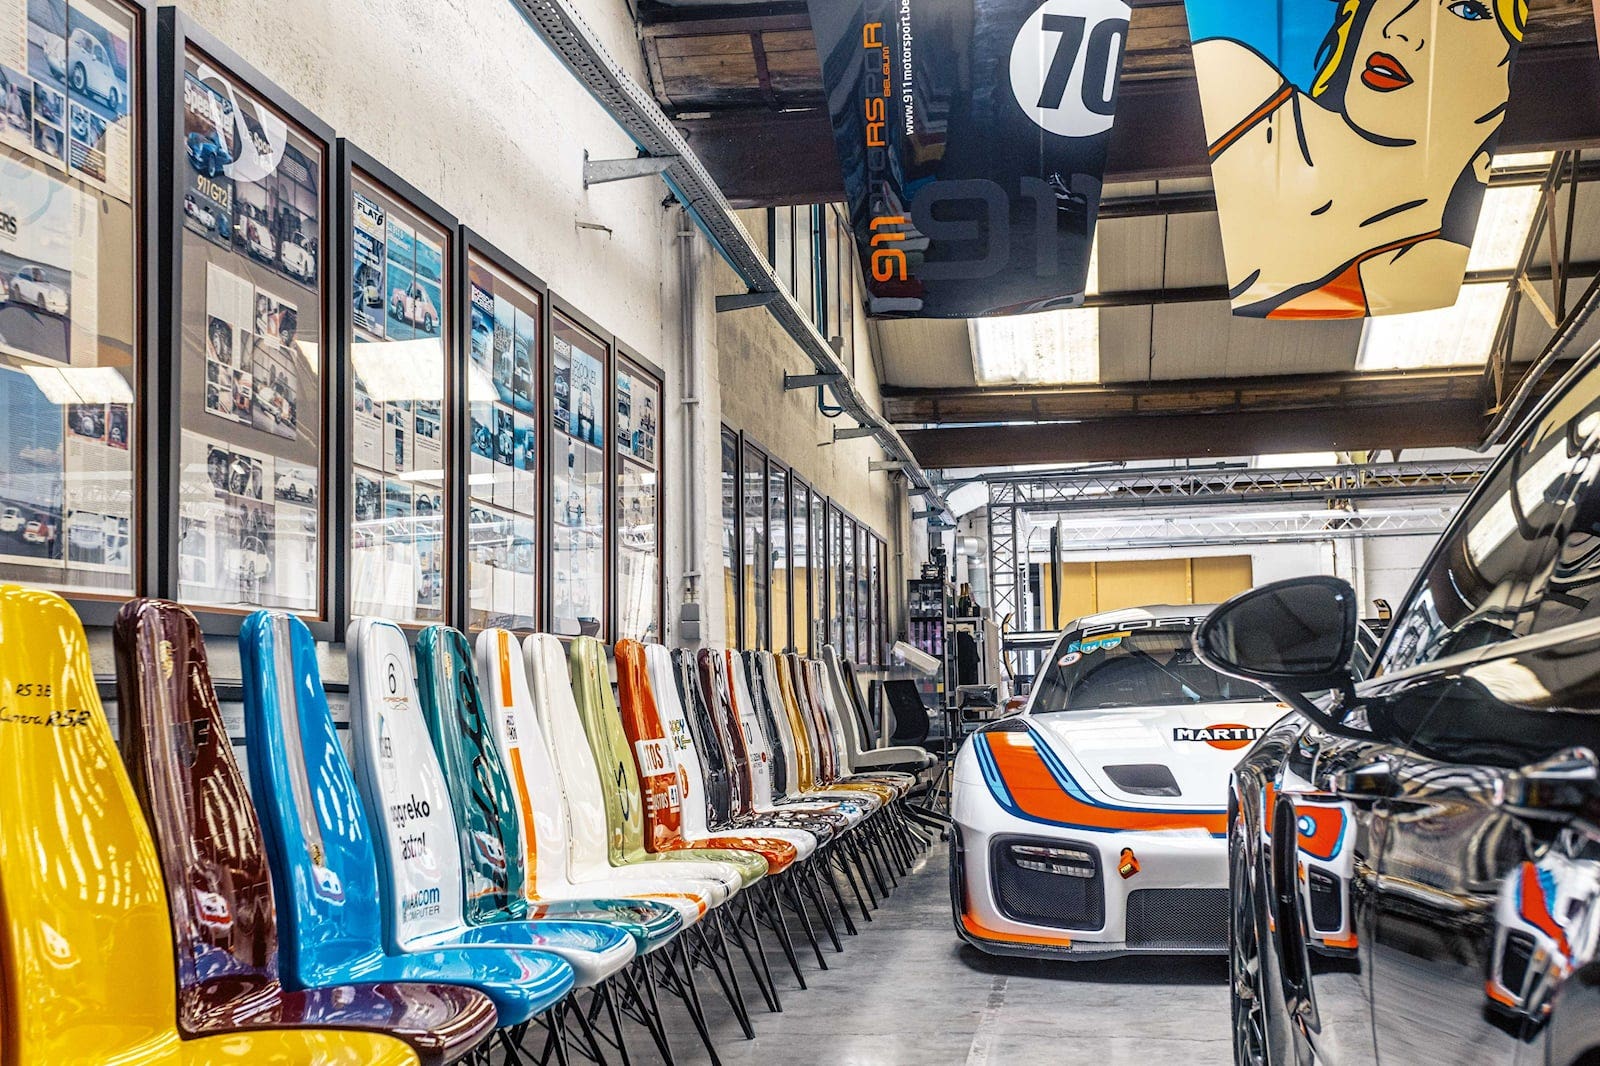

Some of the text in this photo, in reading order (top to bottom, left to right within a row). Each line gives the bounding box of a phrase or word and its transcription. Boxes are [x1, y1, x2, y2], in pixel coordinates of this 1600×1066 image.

[900, 0, 914, 135] www.911motorsport.be
[1036, 13, 1129, 116] 70
[197, 174, 210, 196] 911
[210, 181, 227, 207] GT2
[357, 202, 377, 221] FLAT
[376, 215, 384, 226] 6
[869, 215, 908, 282] 911
[388, 662, 397, 694] 6
